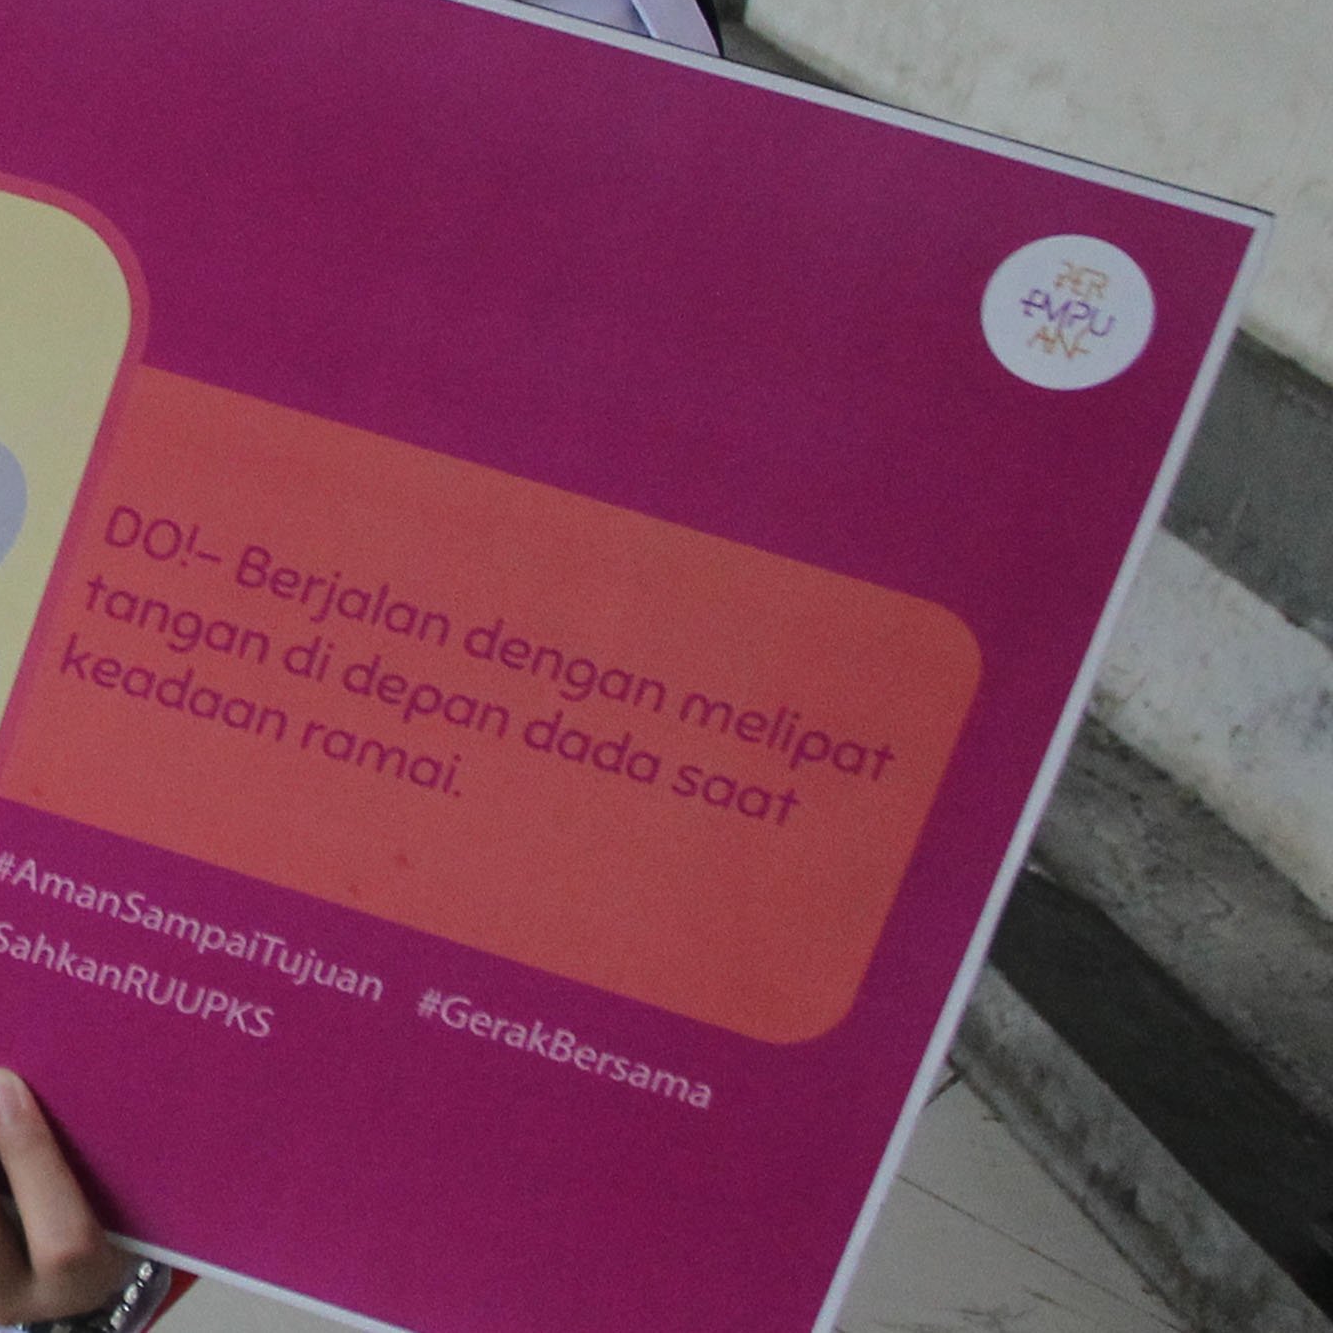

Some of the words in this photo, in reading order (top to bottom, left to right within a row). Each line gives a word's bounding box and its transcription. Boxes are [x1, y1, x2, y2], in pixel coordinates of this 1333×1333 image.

[59, 632, 288, 743] keadaan
[300, 719, 464, 798] ramai.
[85, 574, 271, 665] tangan
[282, 635, 335, 683] di
[341, 654, 511, 739] depan
[523, 709, 661, 785] dada
[671, 763, 800, 827] saat
[235, 544, 451, 647] Berjalan
[462, 617, 668, 713] dengan
[679, 691, 895, 782] melipat
[416, 987, 713, 1110] #GerakBersama
